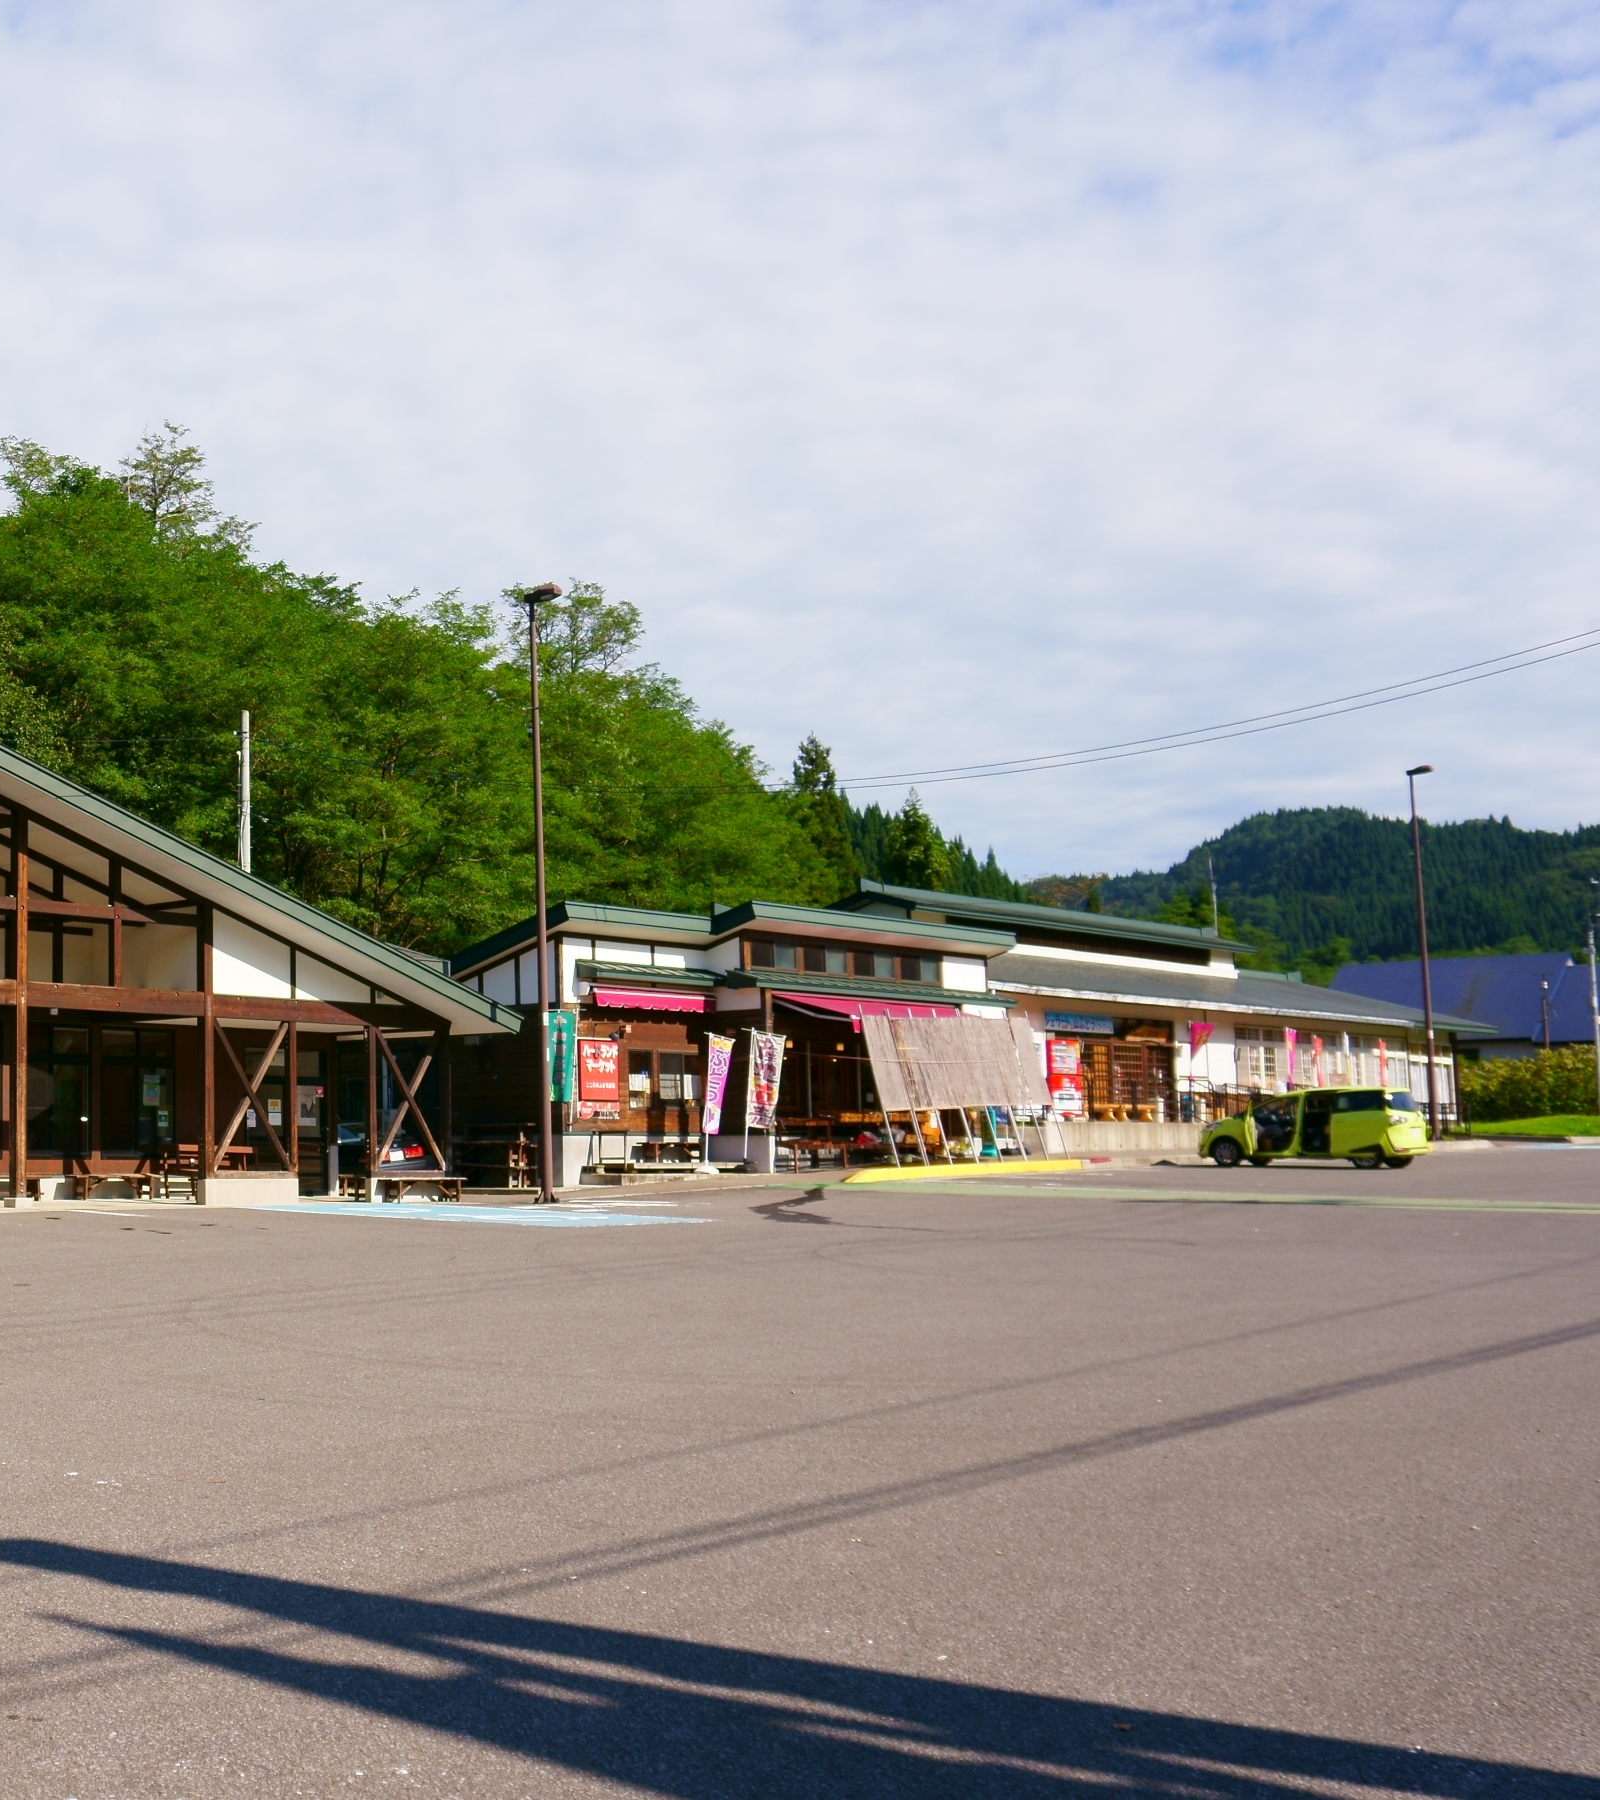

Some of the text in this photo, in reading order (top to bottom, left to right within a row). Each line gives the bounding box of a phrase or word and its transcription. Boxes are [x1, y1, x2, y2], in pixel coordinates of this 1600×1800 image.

[582, 1044, 619, 1059] ハートランド
[585, 1059, 616, 1074] マーケット
